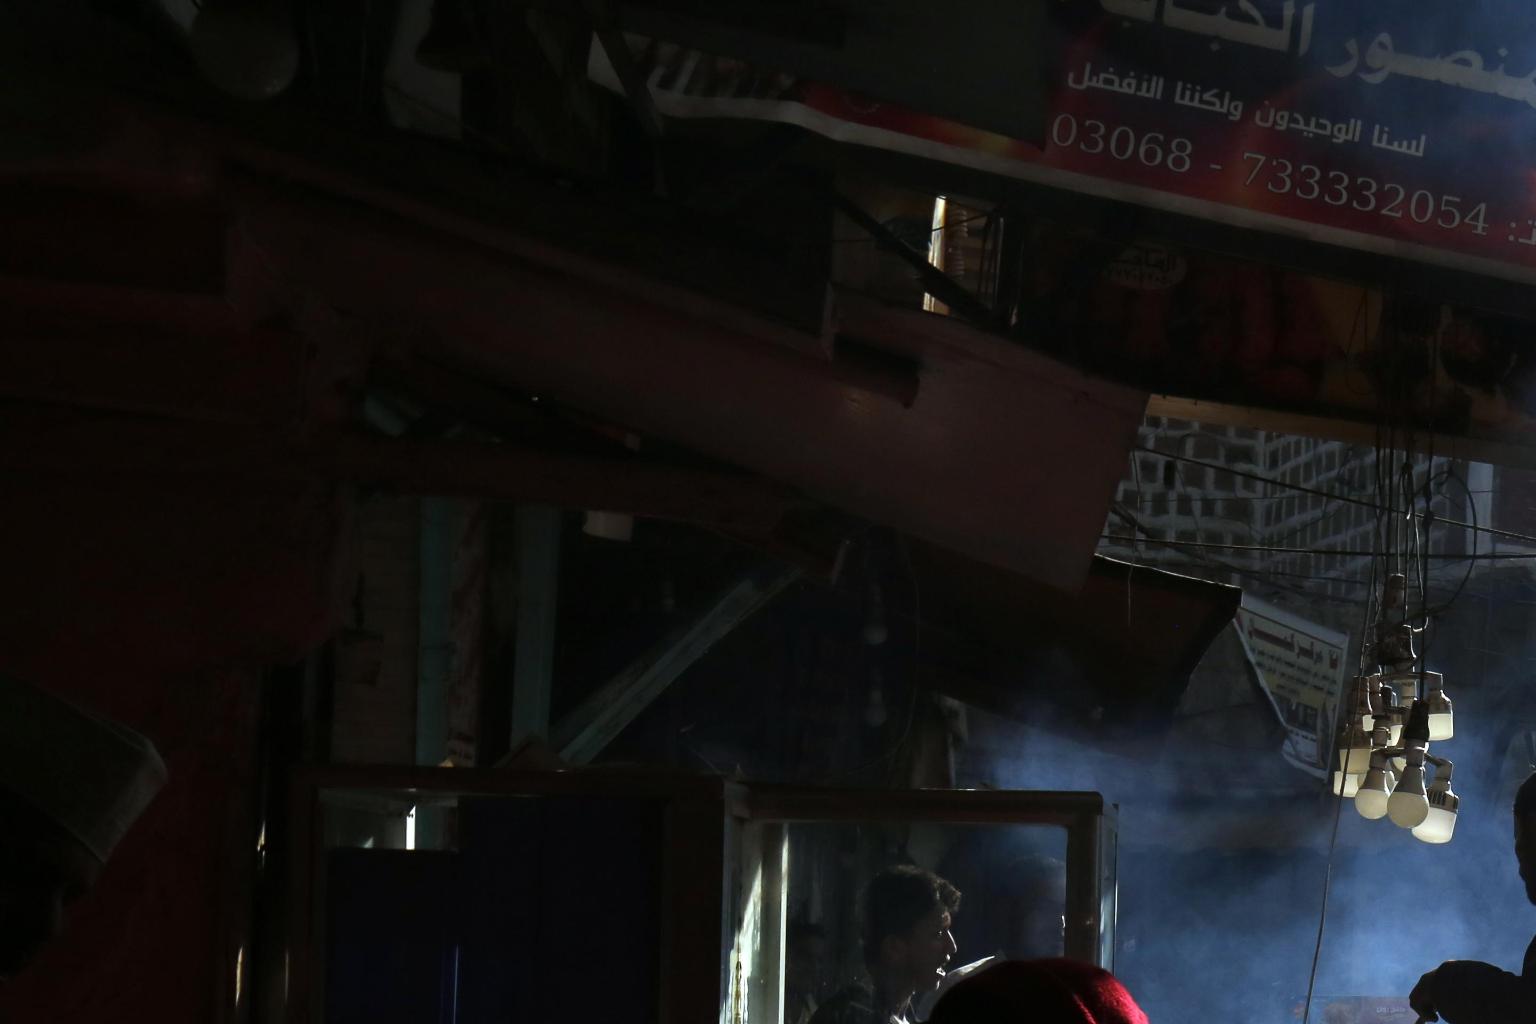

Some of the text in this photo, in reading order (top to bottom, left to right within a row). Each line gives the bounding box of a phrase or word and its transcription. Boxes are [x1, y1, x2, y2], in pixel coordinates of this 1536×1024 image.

[1174, 80, 1244, 121] ولكننا
[1255, 100, 1362, 144] الوحيدون
[1051, 112, 1193, 173] 03068
[1372, 123, 1427, 157] لسنا
[1242, 152, 1489, 236] 733332054
